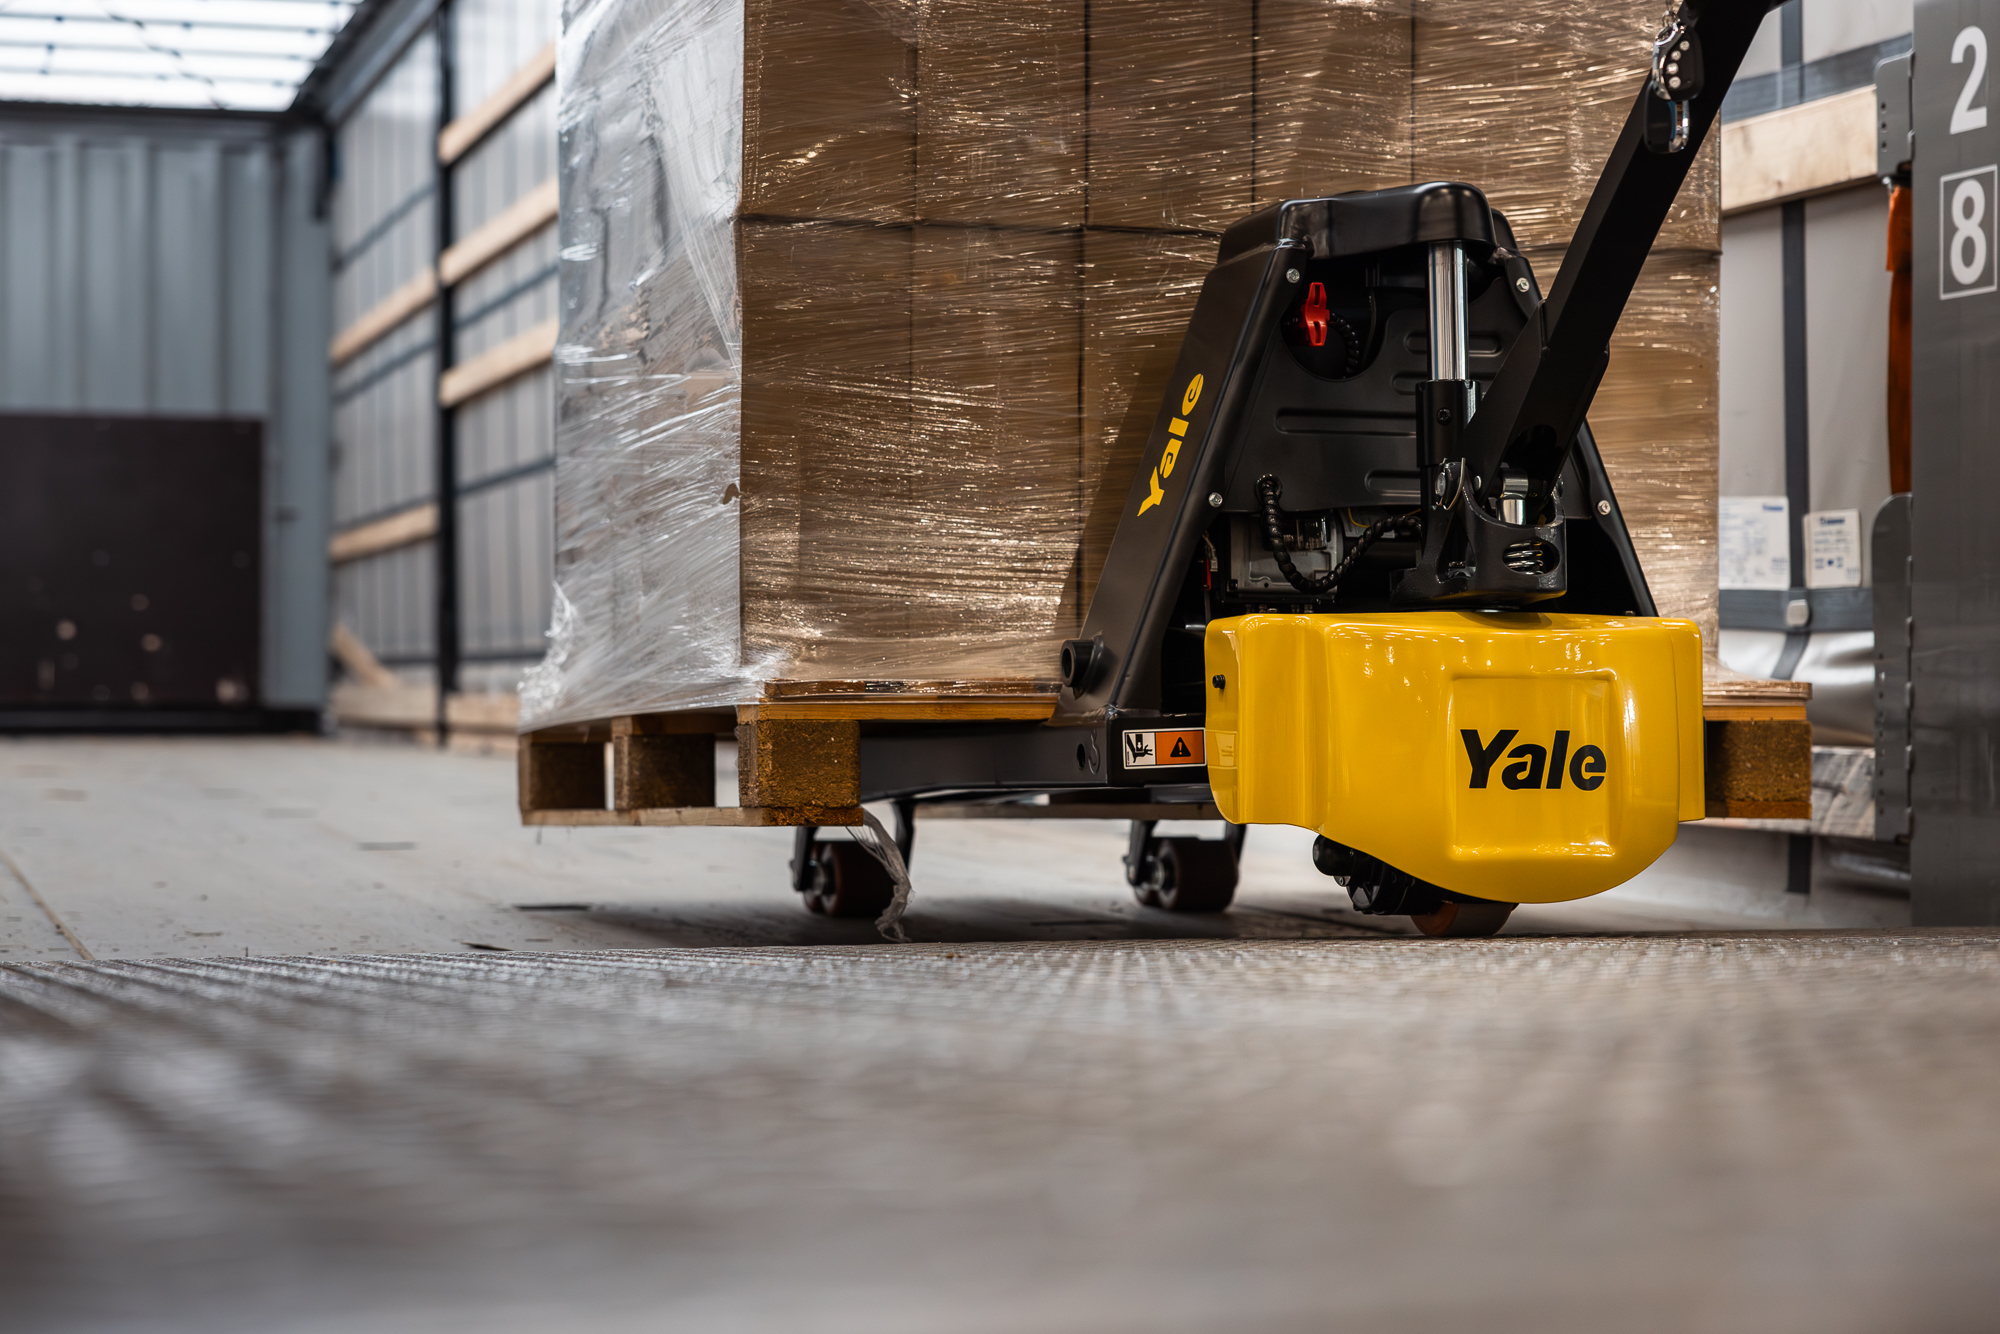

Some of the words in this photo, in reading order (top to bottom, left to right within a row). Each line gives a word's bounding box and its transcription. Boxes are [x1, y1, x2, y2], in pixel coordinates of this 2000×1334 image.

[1950, 25, 1988, 135] 2
[1950, 178, 1987, 285] 8
[1137, 373, 1204, 517] Yale
[1460, 729, 1606, 791] Yale
